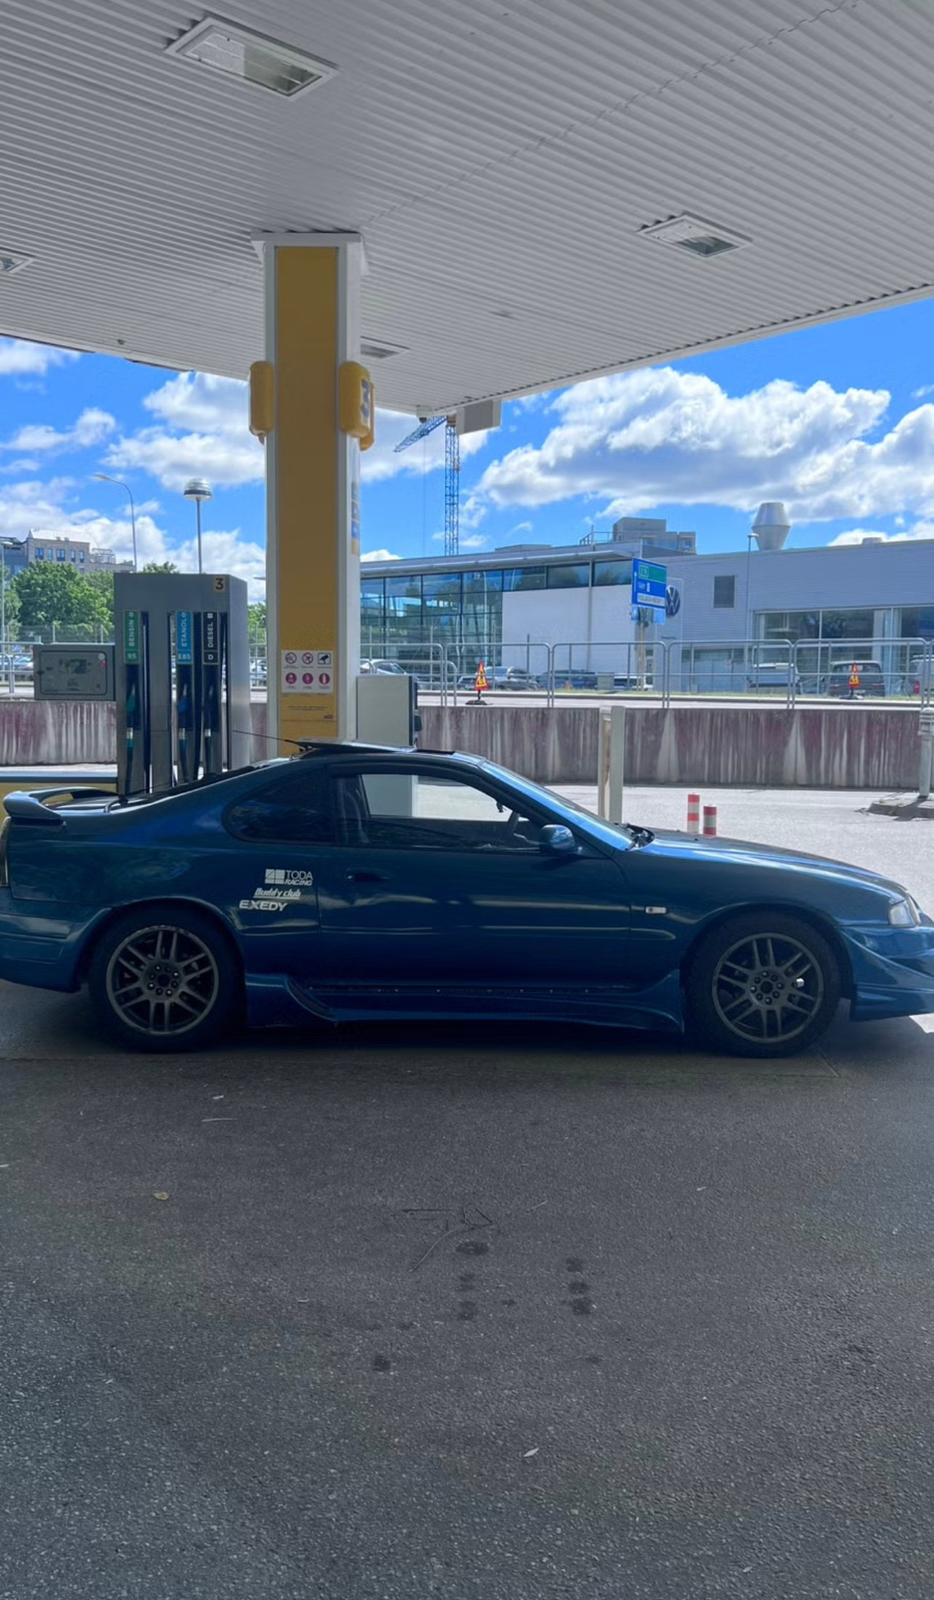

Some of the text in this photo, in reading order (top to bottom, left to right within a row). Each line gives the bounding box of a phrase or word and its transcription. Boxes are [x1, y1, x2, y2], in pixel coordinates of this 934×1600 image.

[215, 577, 224, 590] 3
[285, 870, 313, 880] TODA
[283, 889, 301, 897] club
[239, 899, 288, 912] EXEDY
